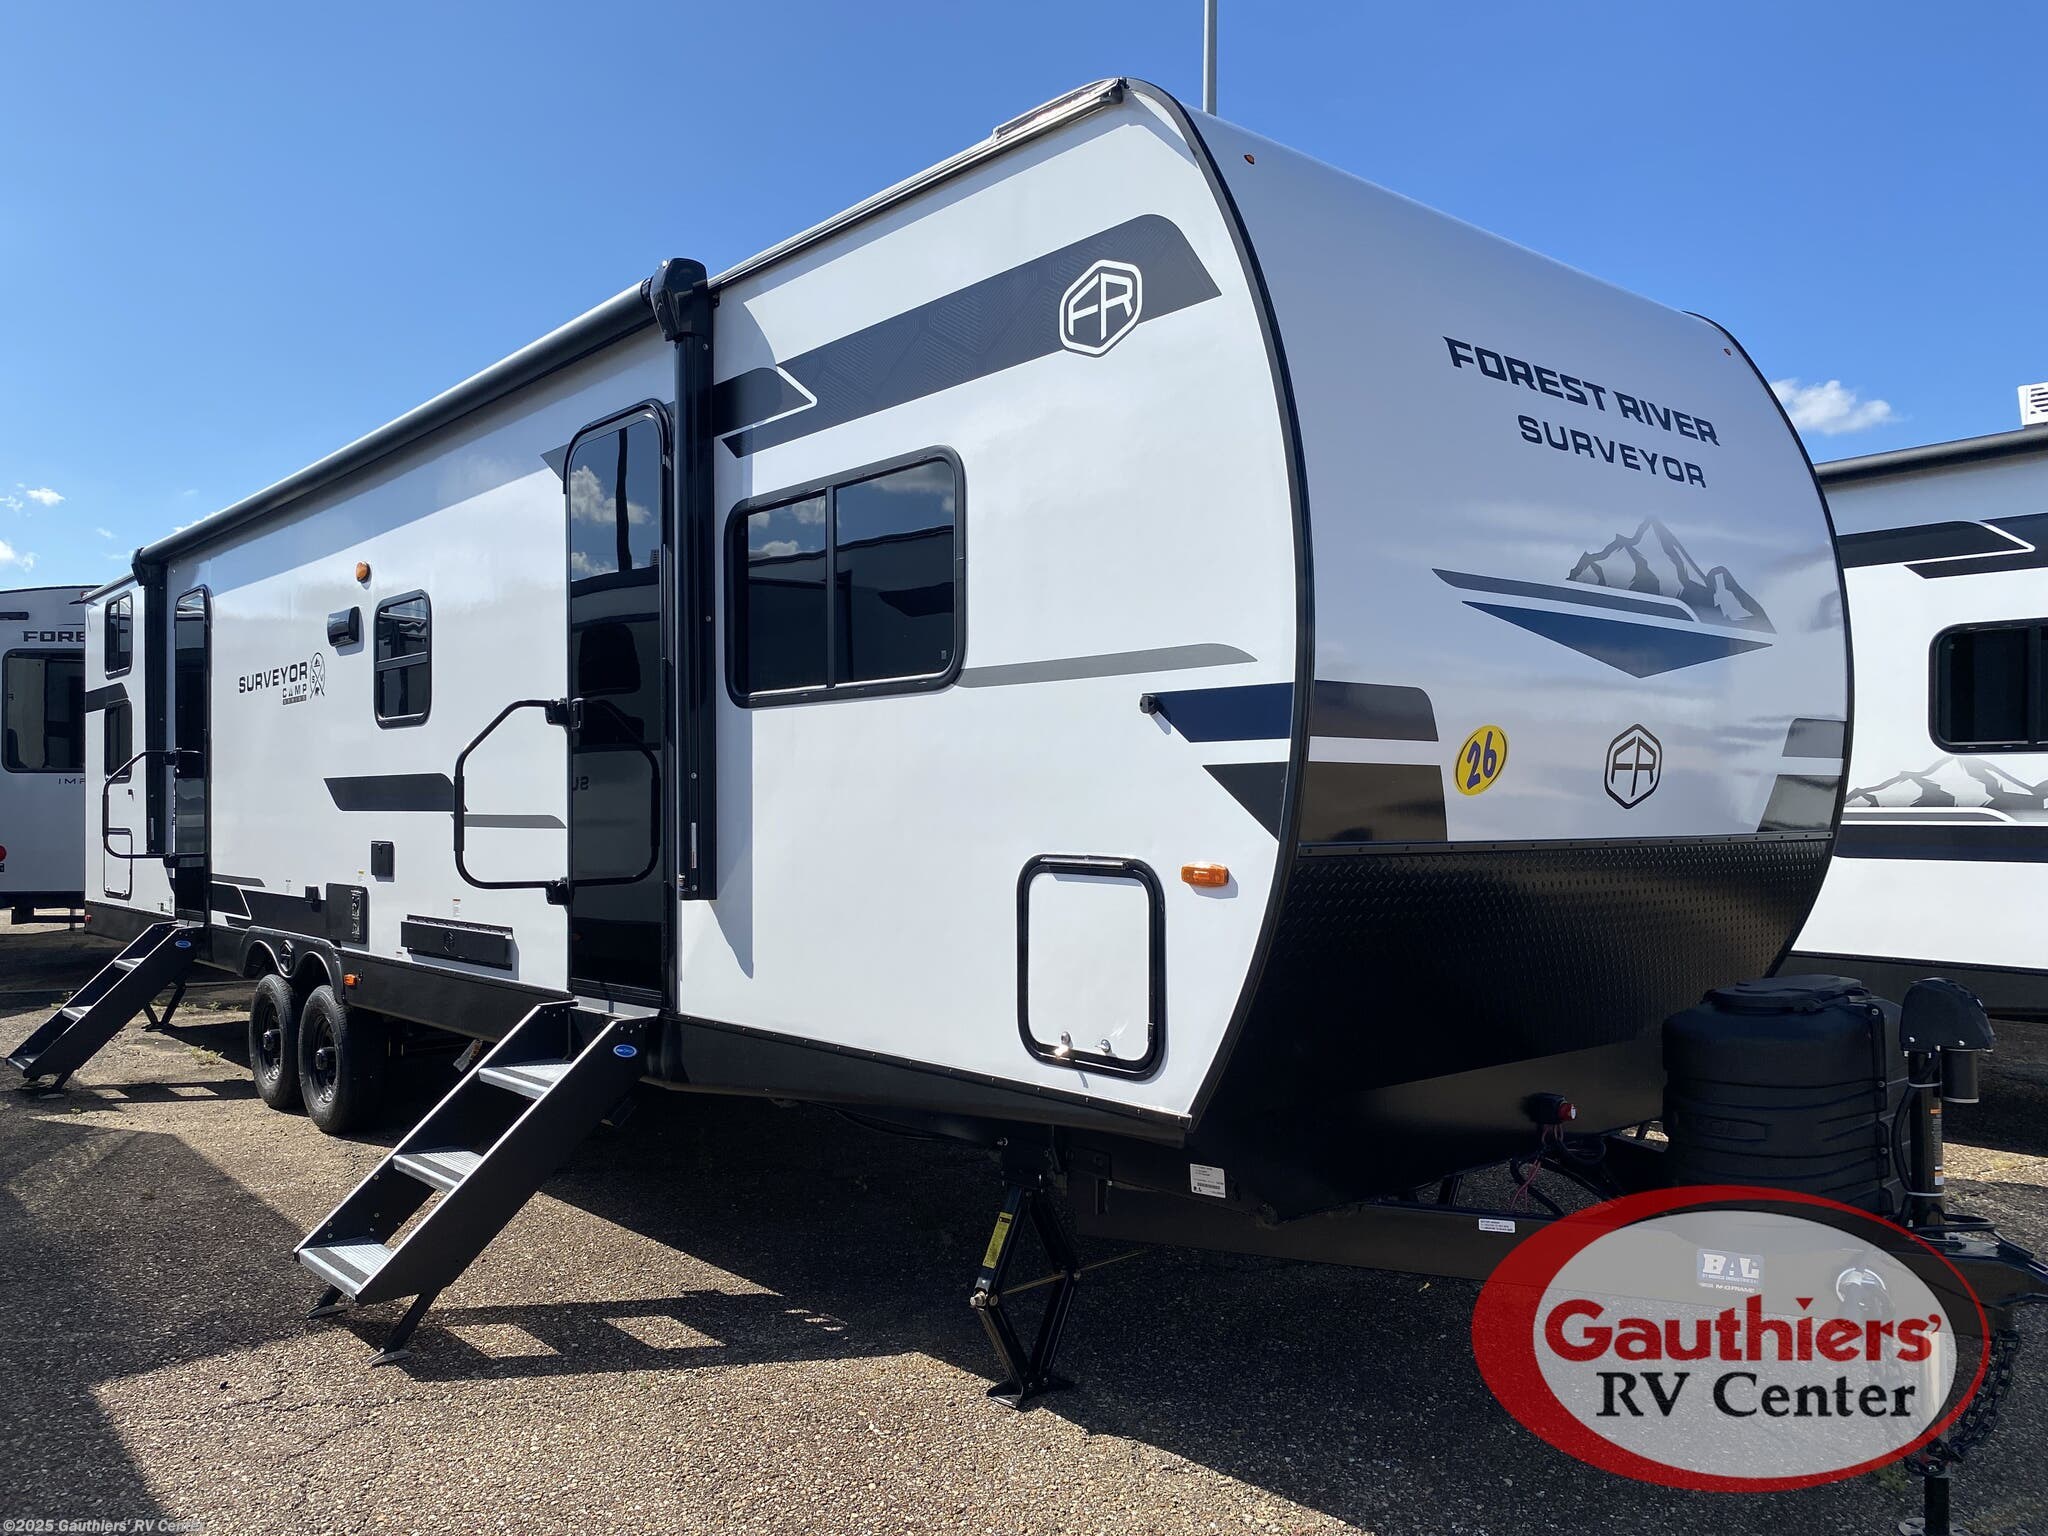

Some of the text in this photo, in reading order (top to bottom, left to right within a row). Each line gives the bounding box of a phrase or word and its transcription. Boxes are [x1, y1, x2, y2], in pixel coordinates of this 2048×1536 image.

[1442, 336, 1721, 447] FOREST RIVER
[1517, 414, 1707, 489] SURVEYOR
[239, 661, 308, 694] SURVEYOR
[282, 683, 307, 698] CAMP
[1466, 730, 1498, 790] 26
[1702, 1253, 1760, 1280] BAL
